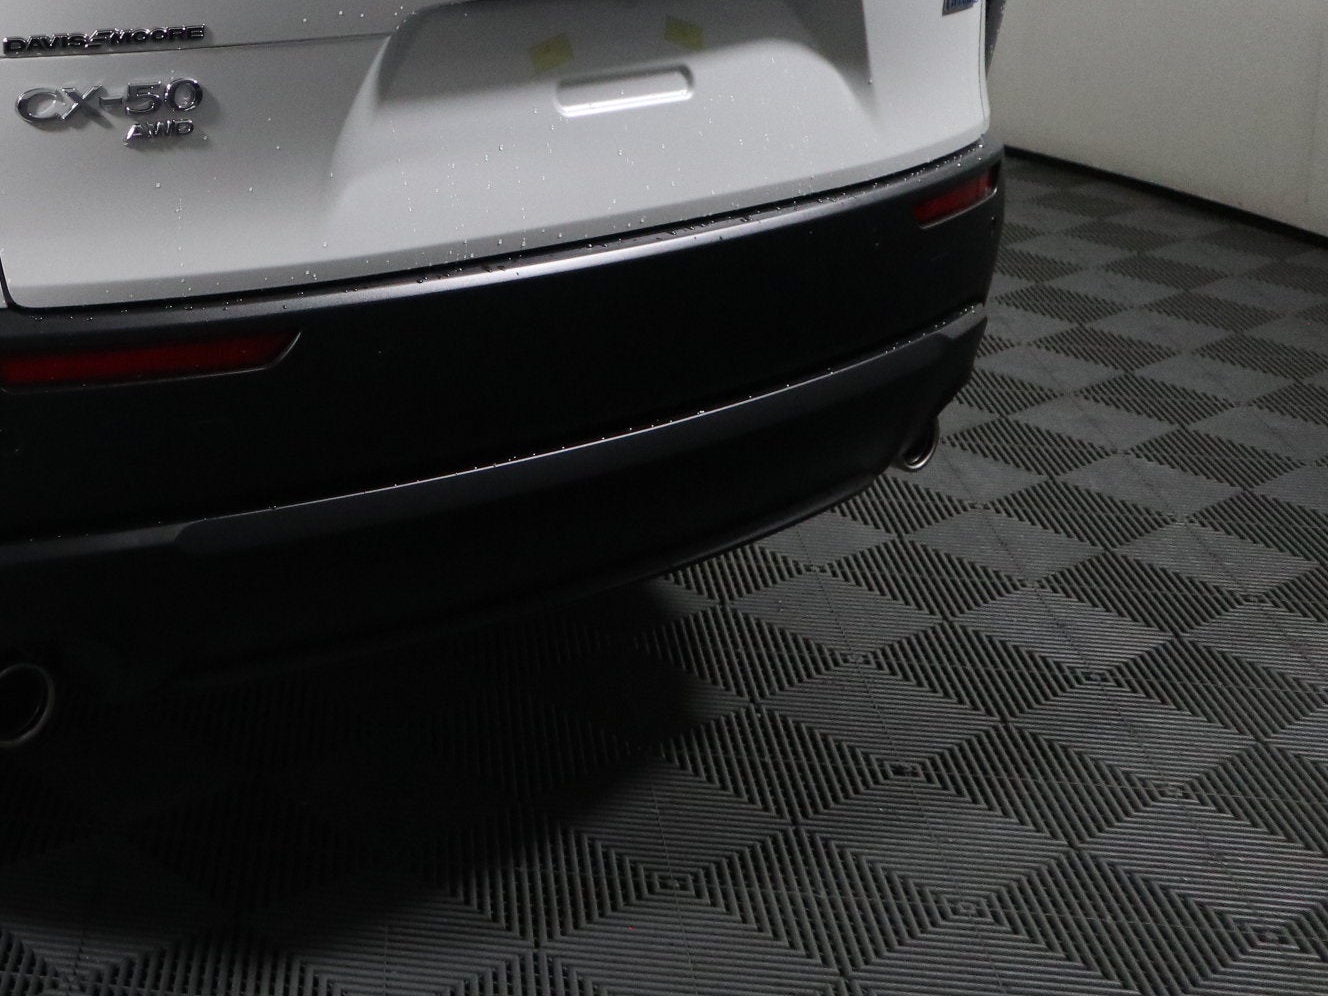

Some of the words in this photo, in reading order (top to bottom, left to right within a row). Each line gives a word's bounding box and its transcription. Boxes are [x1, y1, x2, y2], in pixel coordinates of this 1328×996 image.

[3, 33, 88, 54] DAVIS
[109, 24, 206, 47] MOORE
[15, 77, 204, 123] CX-50
[125, 118, 194, 144] AWD
